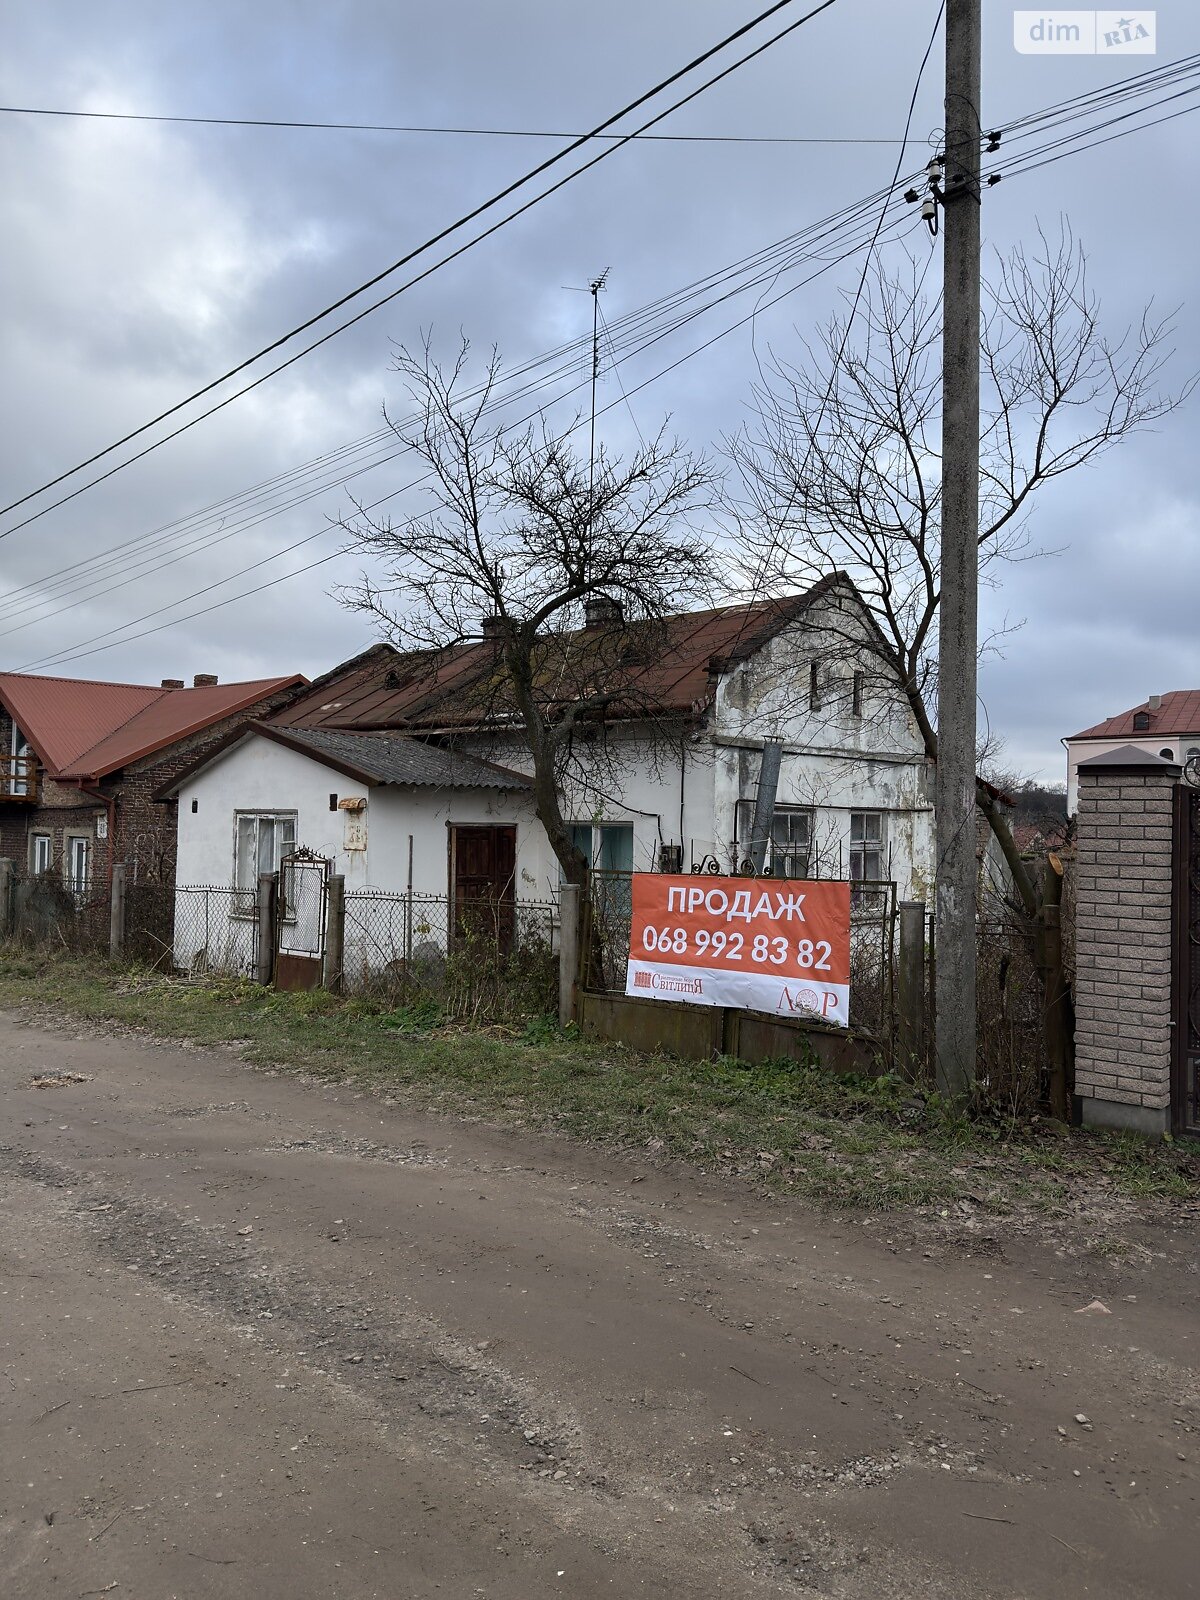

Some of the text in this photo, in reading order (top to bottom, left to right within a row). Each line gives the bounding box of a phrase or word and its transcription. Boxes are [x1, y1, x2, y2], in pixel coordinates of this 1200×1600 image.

[667, 887, 806, 923] ПРОДАЖ
[642, 925, 832, 971] 068 992 83 82
